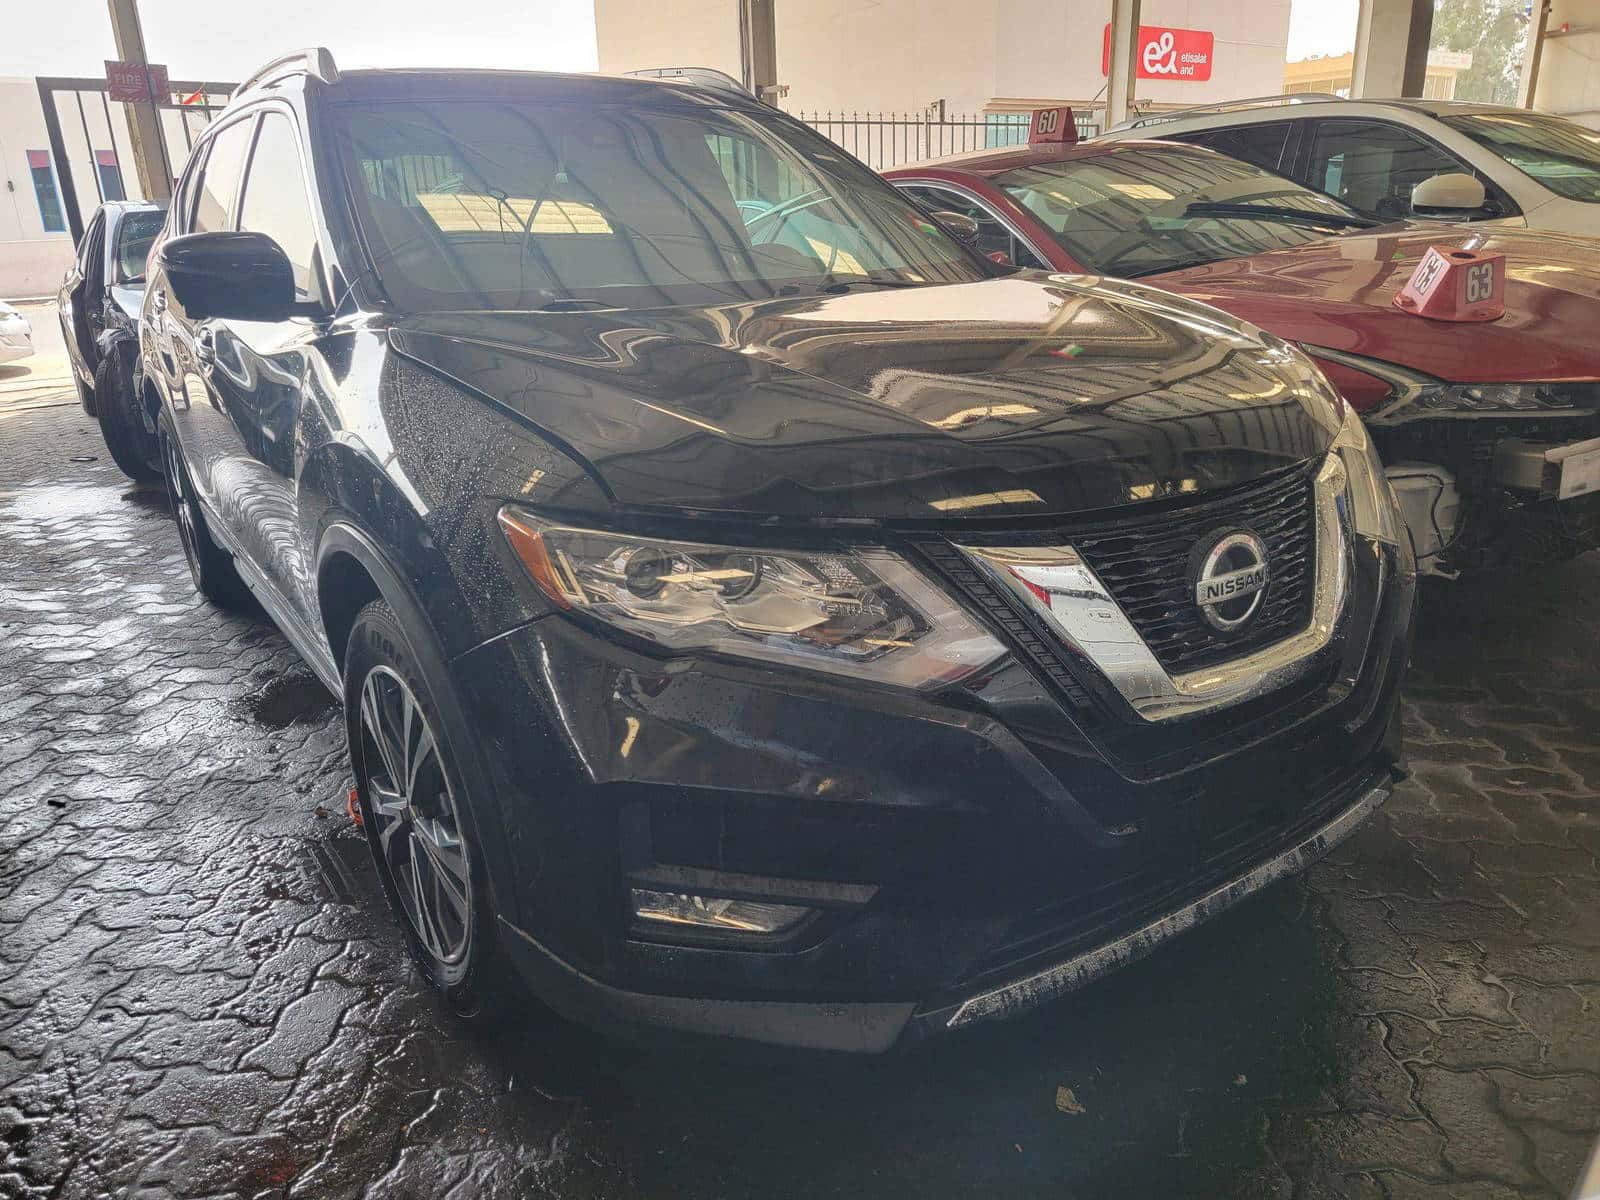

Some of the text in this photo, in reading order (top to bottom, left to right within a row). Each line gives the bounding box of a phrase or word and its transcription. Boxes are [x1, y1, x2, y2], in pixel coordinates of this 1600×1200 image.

[1179, 65, 1194, 75] and
[1037, 110, 1059, 135] 60
[1413, 254, 1443, 295] 63
[1465, 261, 1495, 304] 63
[1207, 570, 1264, 599] NISSAN
